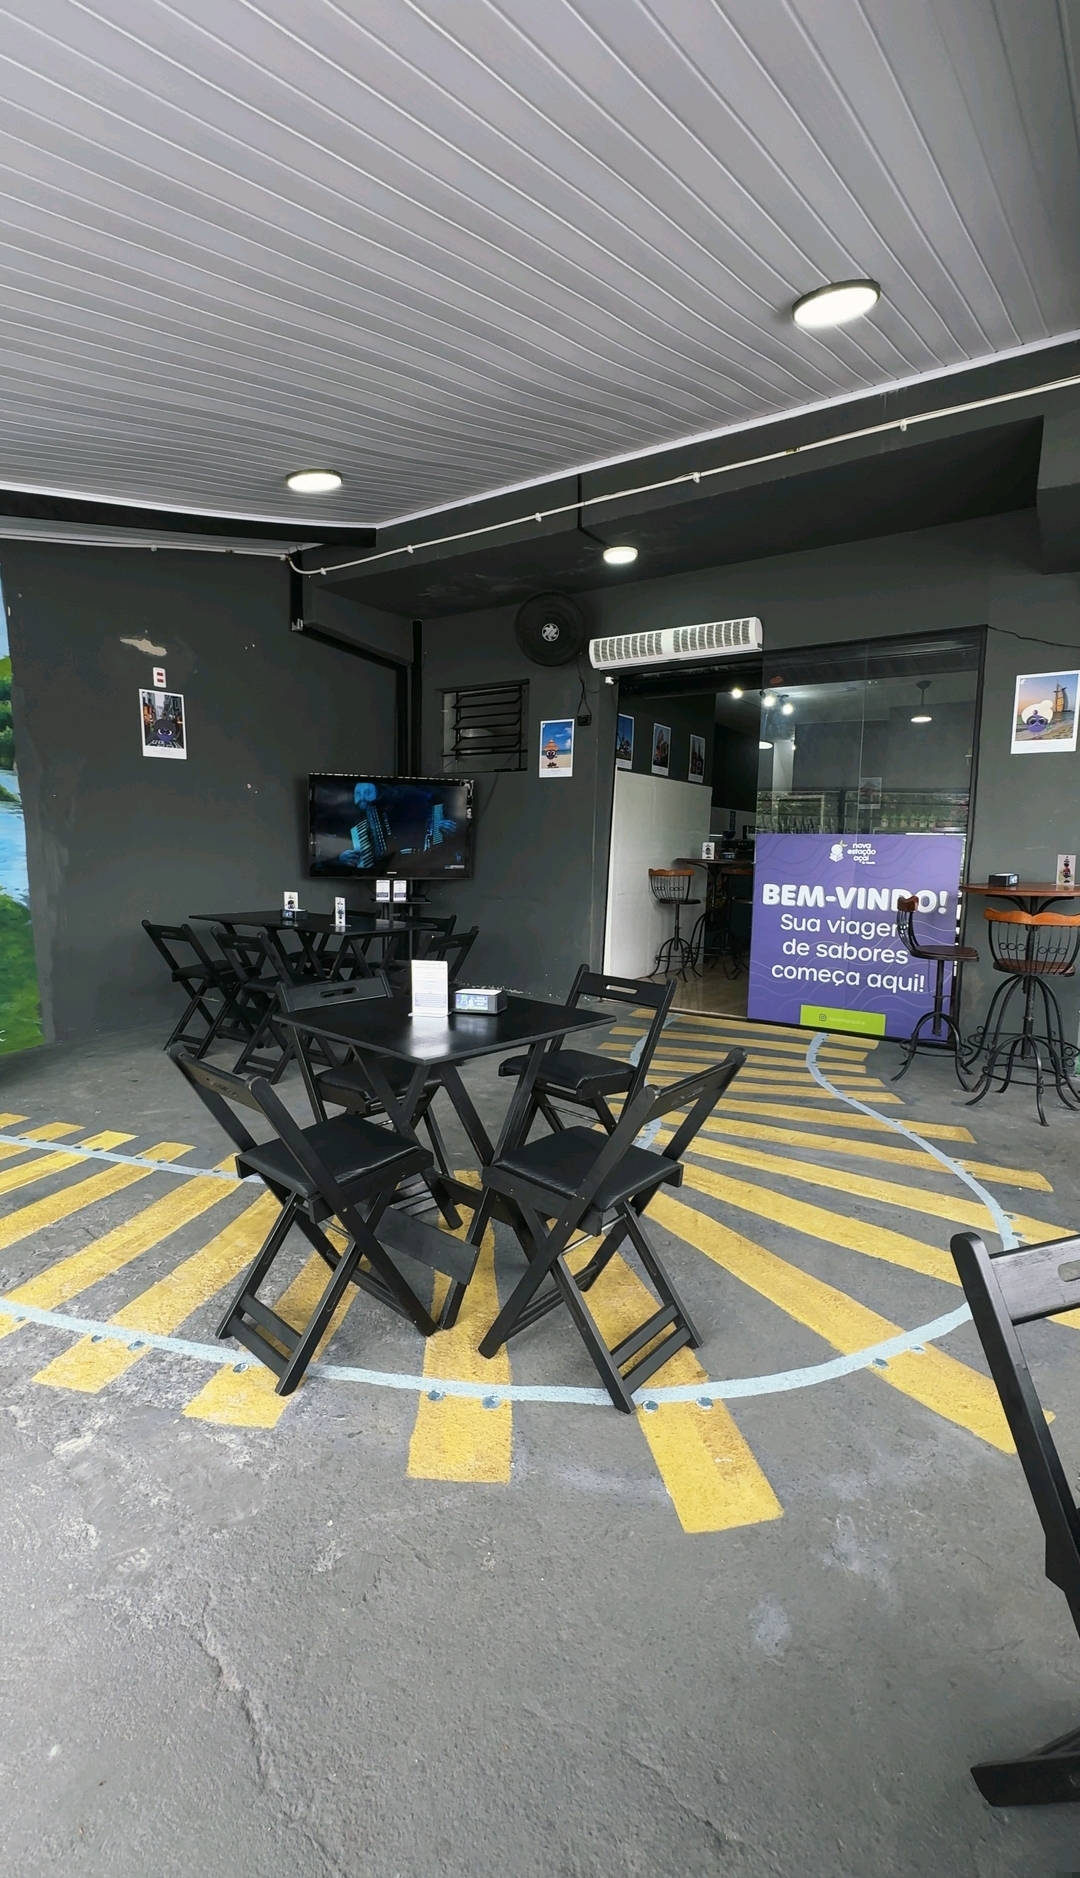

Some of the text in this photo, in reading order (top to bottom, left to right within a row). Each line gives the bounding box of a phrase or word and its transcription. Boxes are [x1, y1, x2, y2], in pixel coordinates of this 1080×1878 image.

[847, 848, 877, 857] estação
[780, 913, 821, 932] Sua
[782, 938, 909, 964] de sabores
[771, 964, 925, 993] começa aqui!
